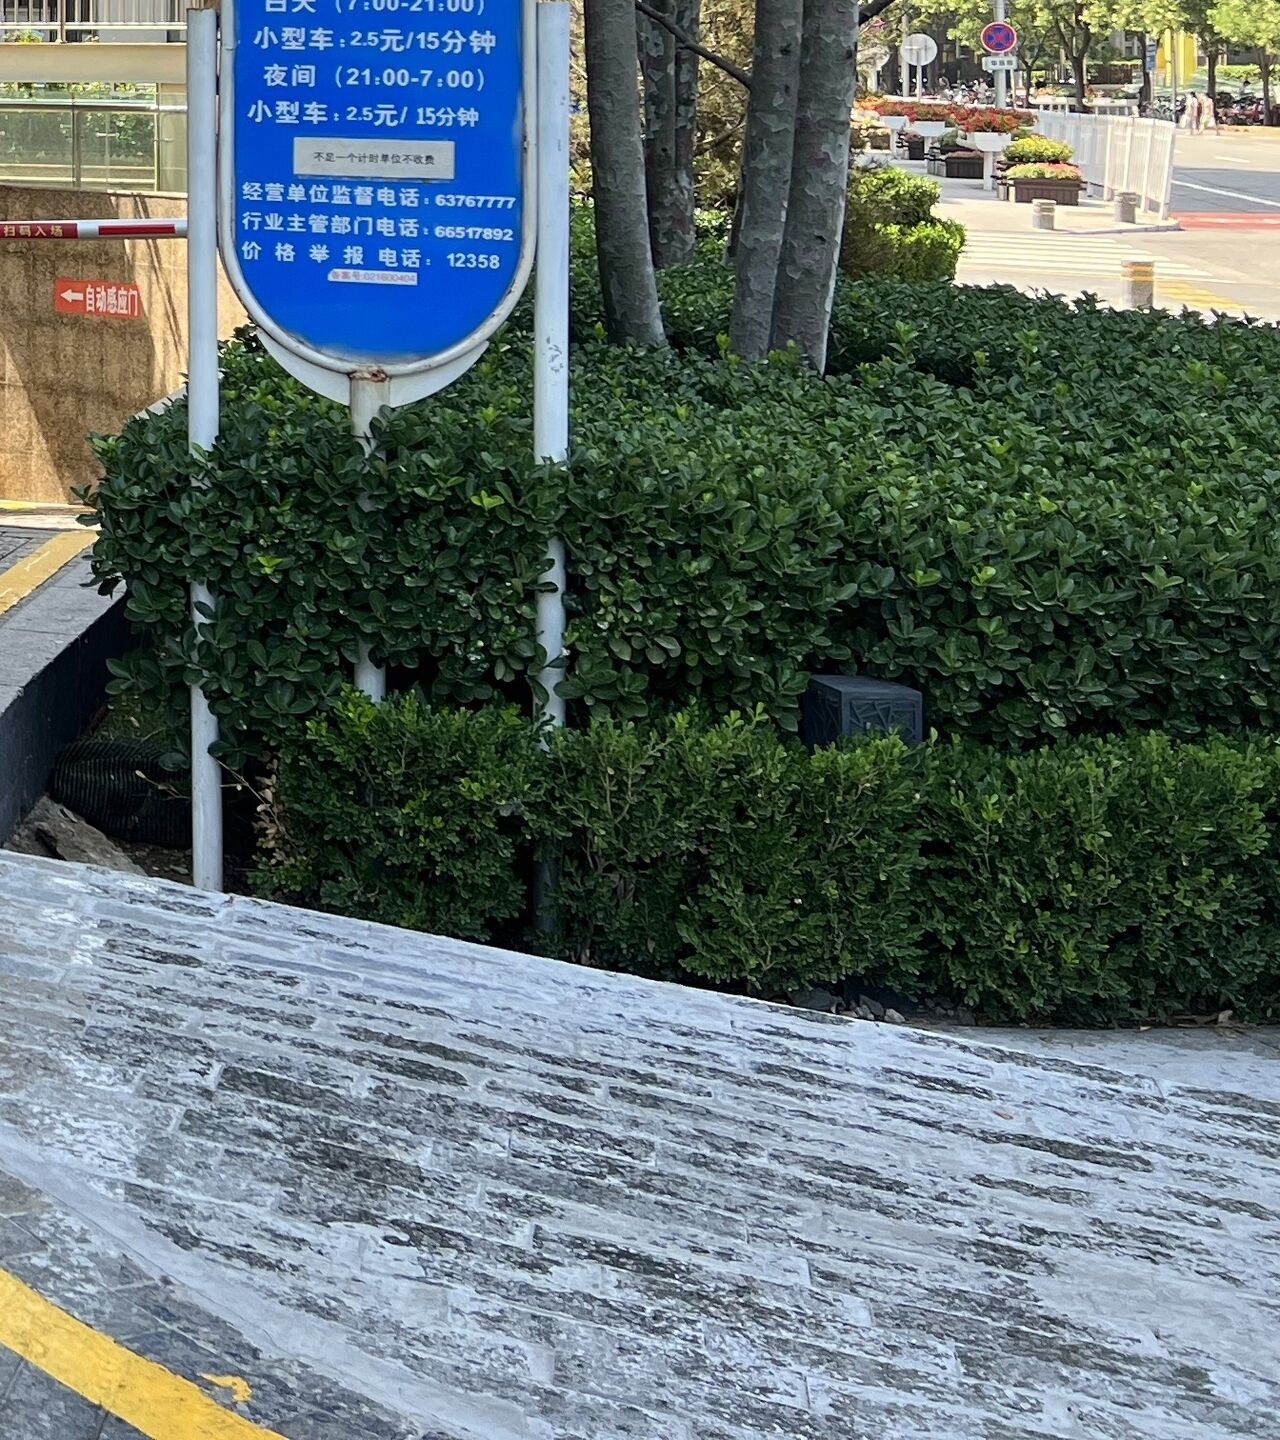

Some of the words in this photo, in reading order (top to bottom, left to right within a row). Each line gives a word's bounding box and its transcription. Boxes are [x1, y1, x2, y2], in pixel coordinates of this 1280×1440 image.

[313, 151, 436, 166] 不足一个计时单位不收费
[3, 225, 64, 237] 扫码入场
[85, 284, 138, 316] 自动感应门
